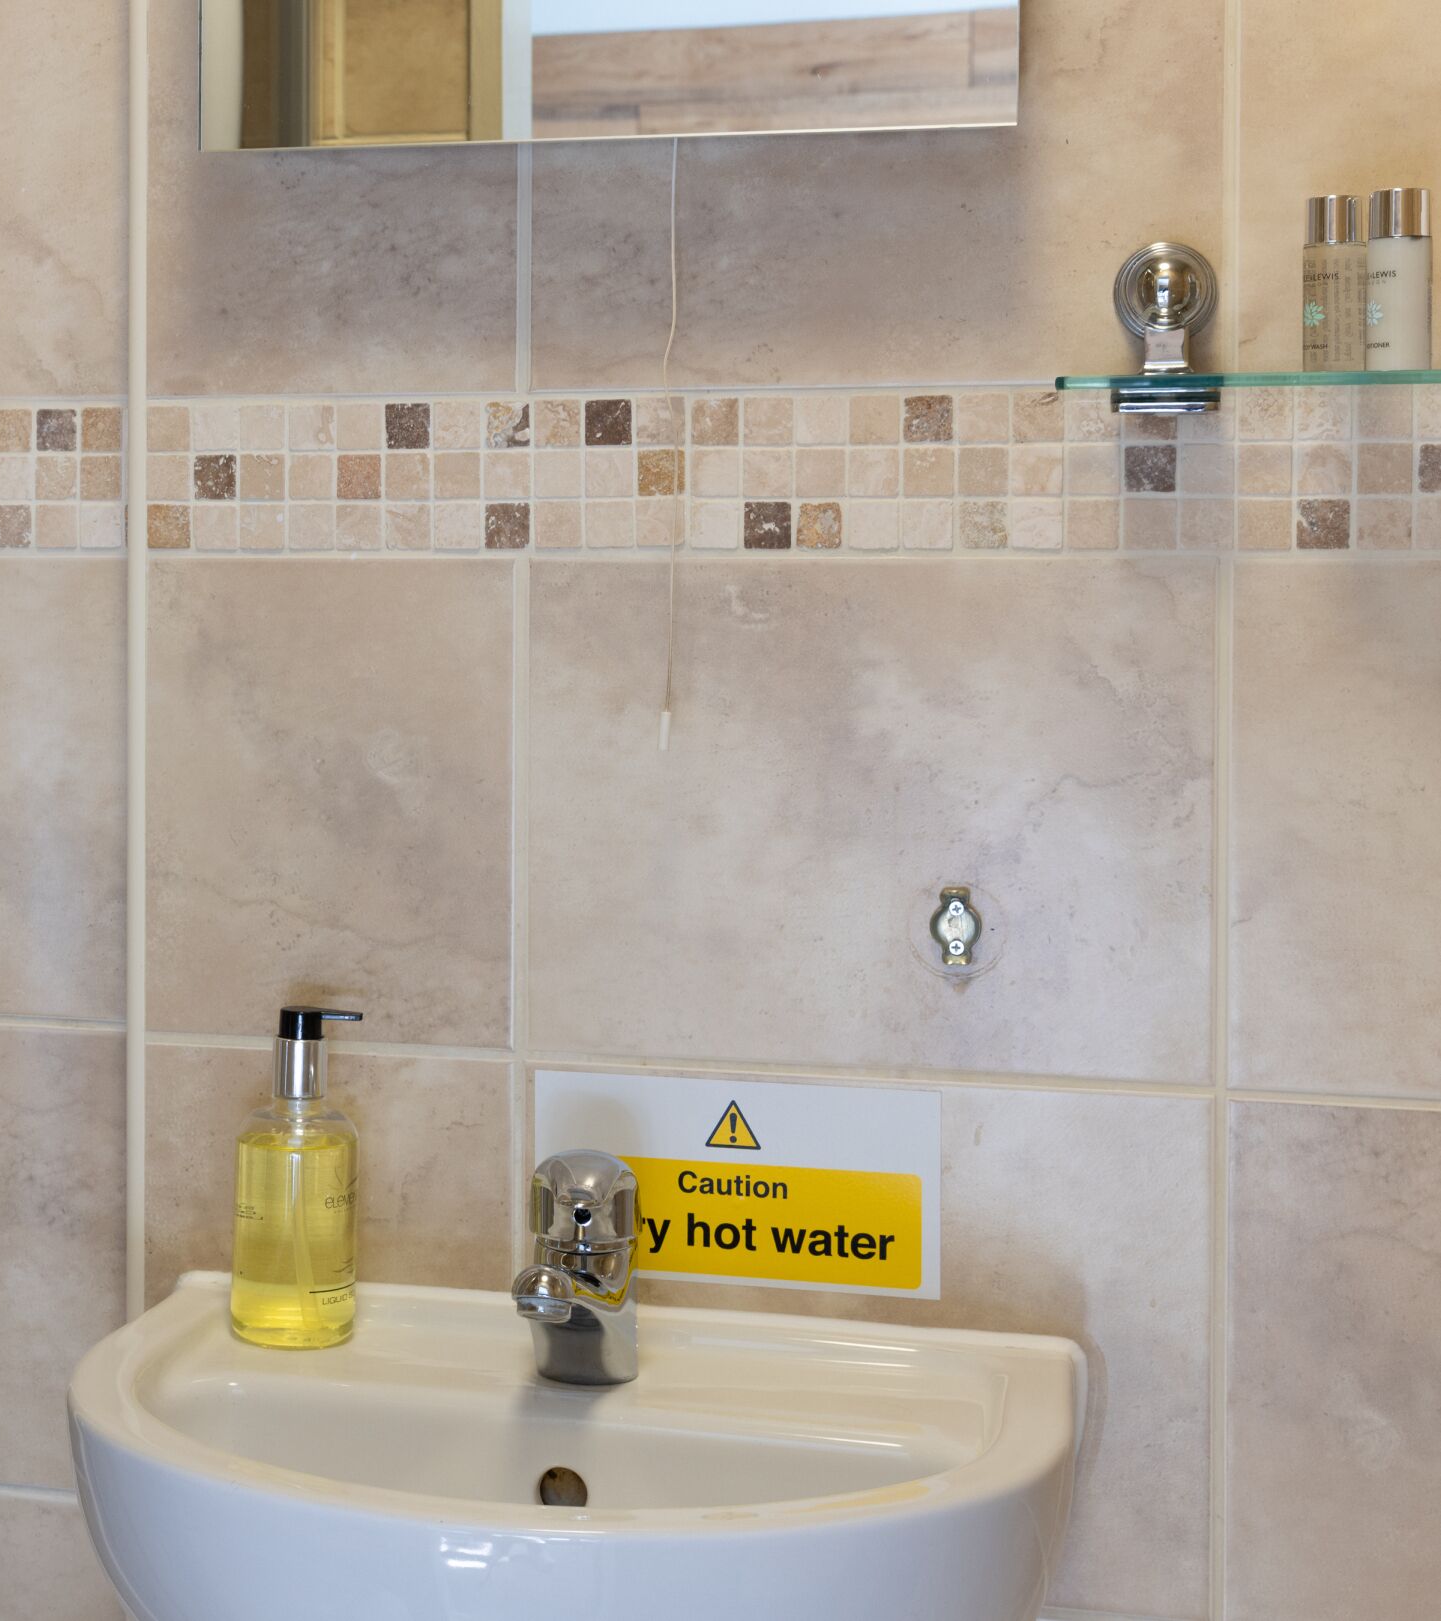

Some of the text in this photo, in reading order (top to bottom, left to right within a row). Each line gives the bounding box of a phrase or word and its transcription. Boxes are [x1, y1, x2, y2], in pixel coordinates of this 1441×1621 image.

[677, 1169, 789, 1200] Caution
[686, 1212, 757, 1251] hot
[770, 1225, 896, 1261] water
